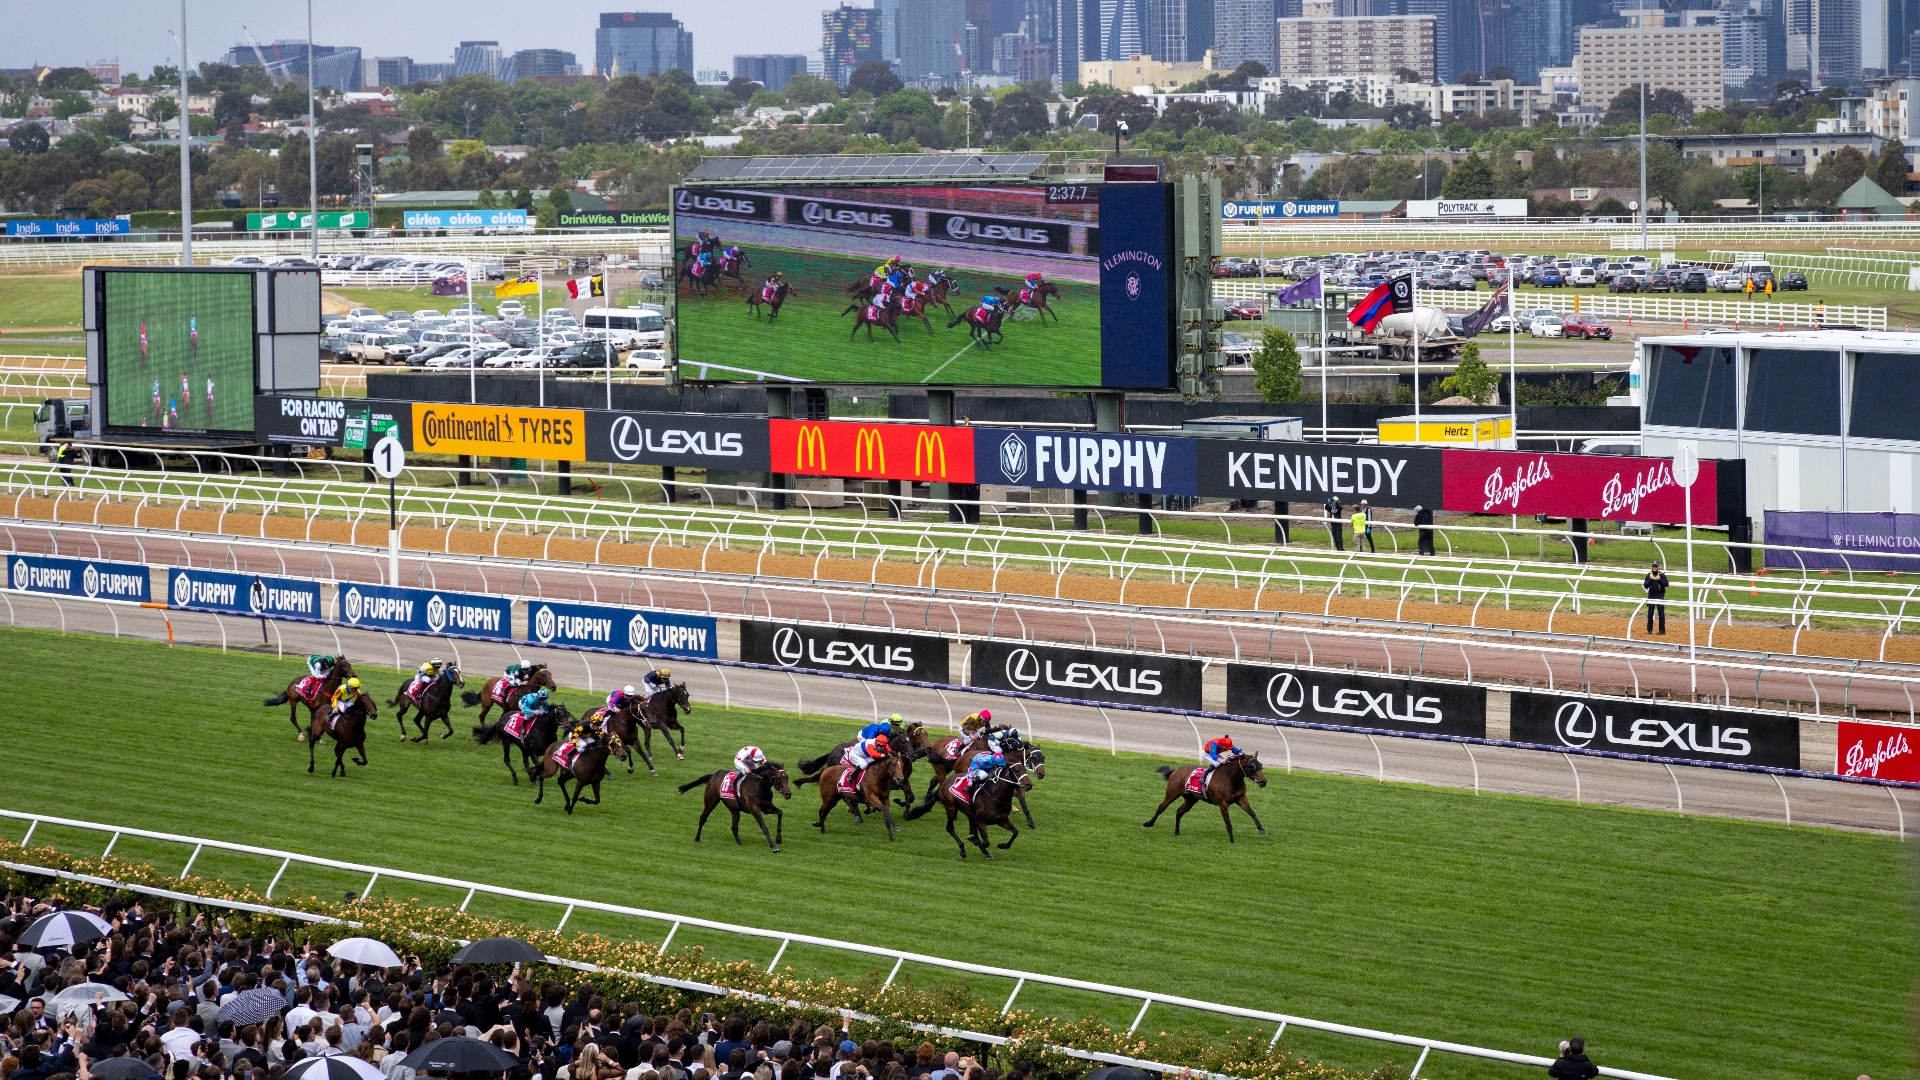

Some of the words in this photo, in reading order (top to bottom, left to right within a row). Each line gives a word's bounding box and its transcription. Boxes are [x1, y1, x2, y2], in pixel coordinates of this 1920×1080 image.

[694, 197, 756, 214] LEXUS
[1050, 186, 1087, 200] 2:37.7
[408, 213, 440, 226] cirka
[449, 212, 482, 225] cirka
[491, 212, 524, 224] cirka
[824, 210, 893, 228] LEXUS
[1299, 204, 1335, 214] FURPHY
[16, 222, 41, 235] Inglis
[56, 222, 80, 234] Inglis
[96, 221, 120, 234] Inglis
[972, 225, 1049, 244] LEXUS
[1104, 250, 1162, 270] FLEMINGTON
[281, 399, 303, 417] FOR
[304, 400, 345, 418] RACING
[300, 418, 317, 435] ON
[318, 419, 338, 436] TAP
[422, 410, 501, 446] Continental
[519, 418, 572, 446] TYRES
[1444, 426, 1468, 436] Hertz
[646, 428, 743, 456] LEXUS
[381, 443, 391, 472] 1
[1036, 436, 1166, 488] FURPHY
[1228, 451, 1408, 496] KENNEDY
[1484, 456, 1550, 510] Penfolds
[1602, 462, 1672, 518] Penfolds
[1846, 534, 1920, 548] FLEMINGTON
[30, 567, 71, 590] FURPHY
[100, 573, 142, 596] FURPHY
[192, 581, 236, 605] FURPHY
[268, 589, 312, 613] FURPHY
[364, 596, 414, 622] FURPHY
[450, 604, 500, 631] FURPHY
[558, 615, 612, 642] FURPHY
[652, 624, 706, 651] FURPHY
[809, 638, 914, 672] LEXUS
[1046, 660, 1162, 696] LEXUS
[1312, 686, 1443, 724] LEXUS
[1606, 716, 1751, 756] LEXUS
[1845, 732, 1909, 777] Penfolds
